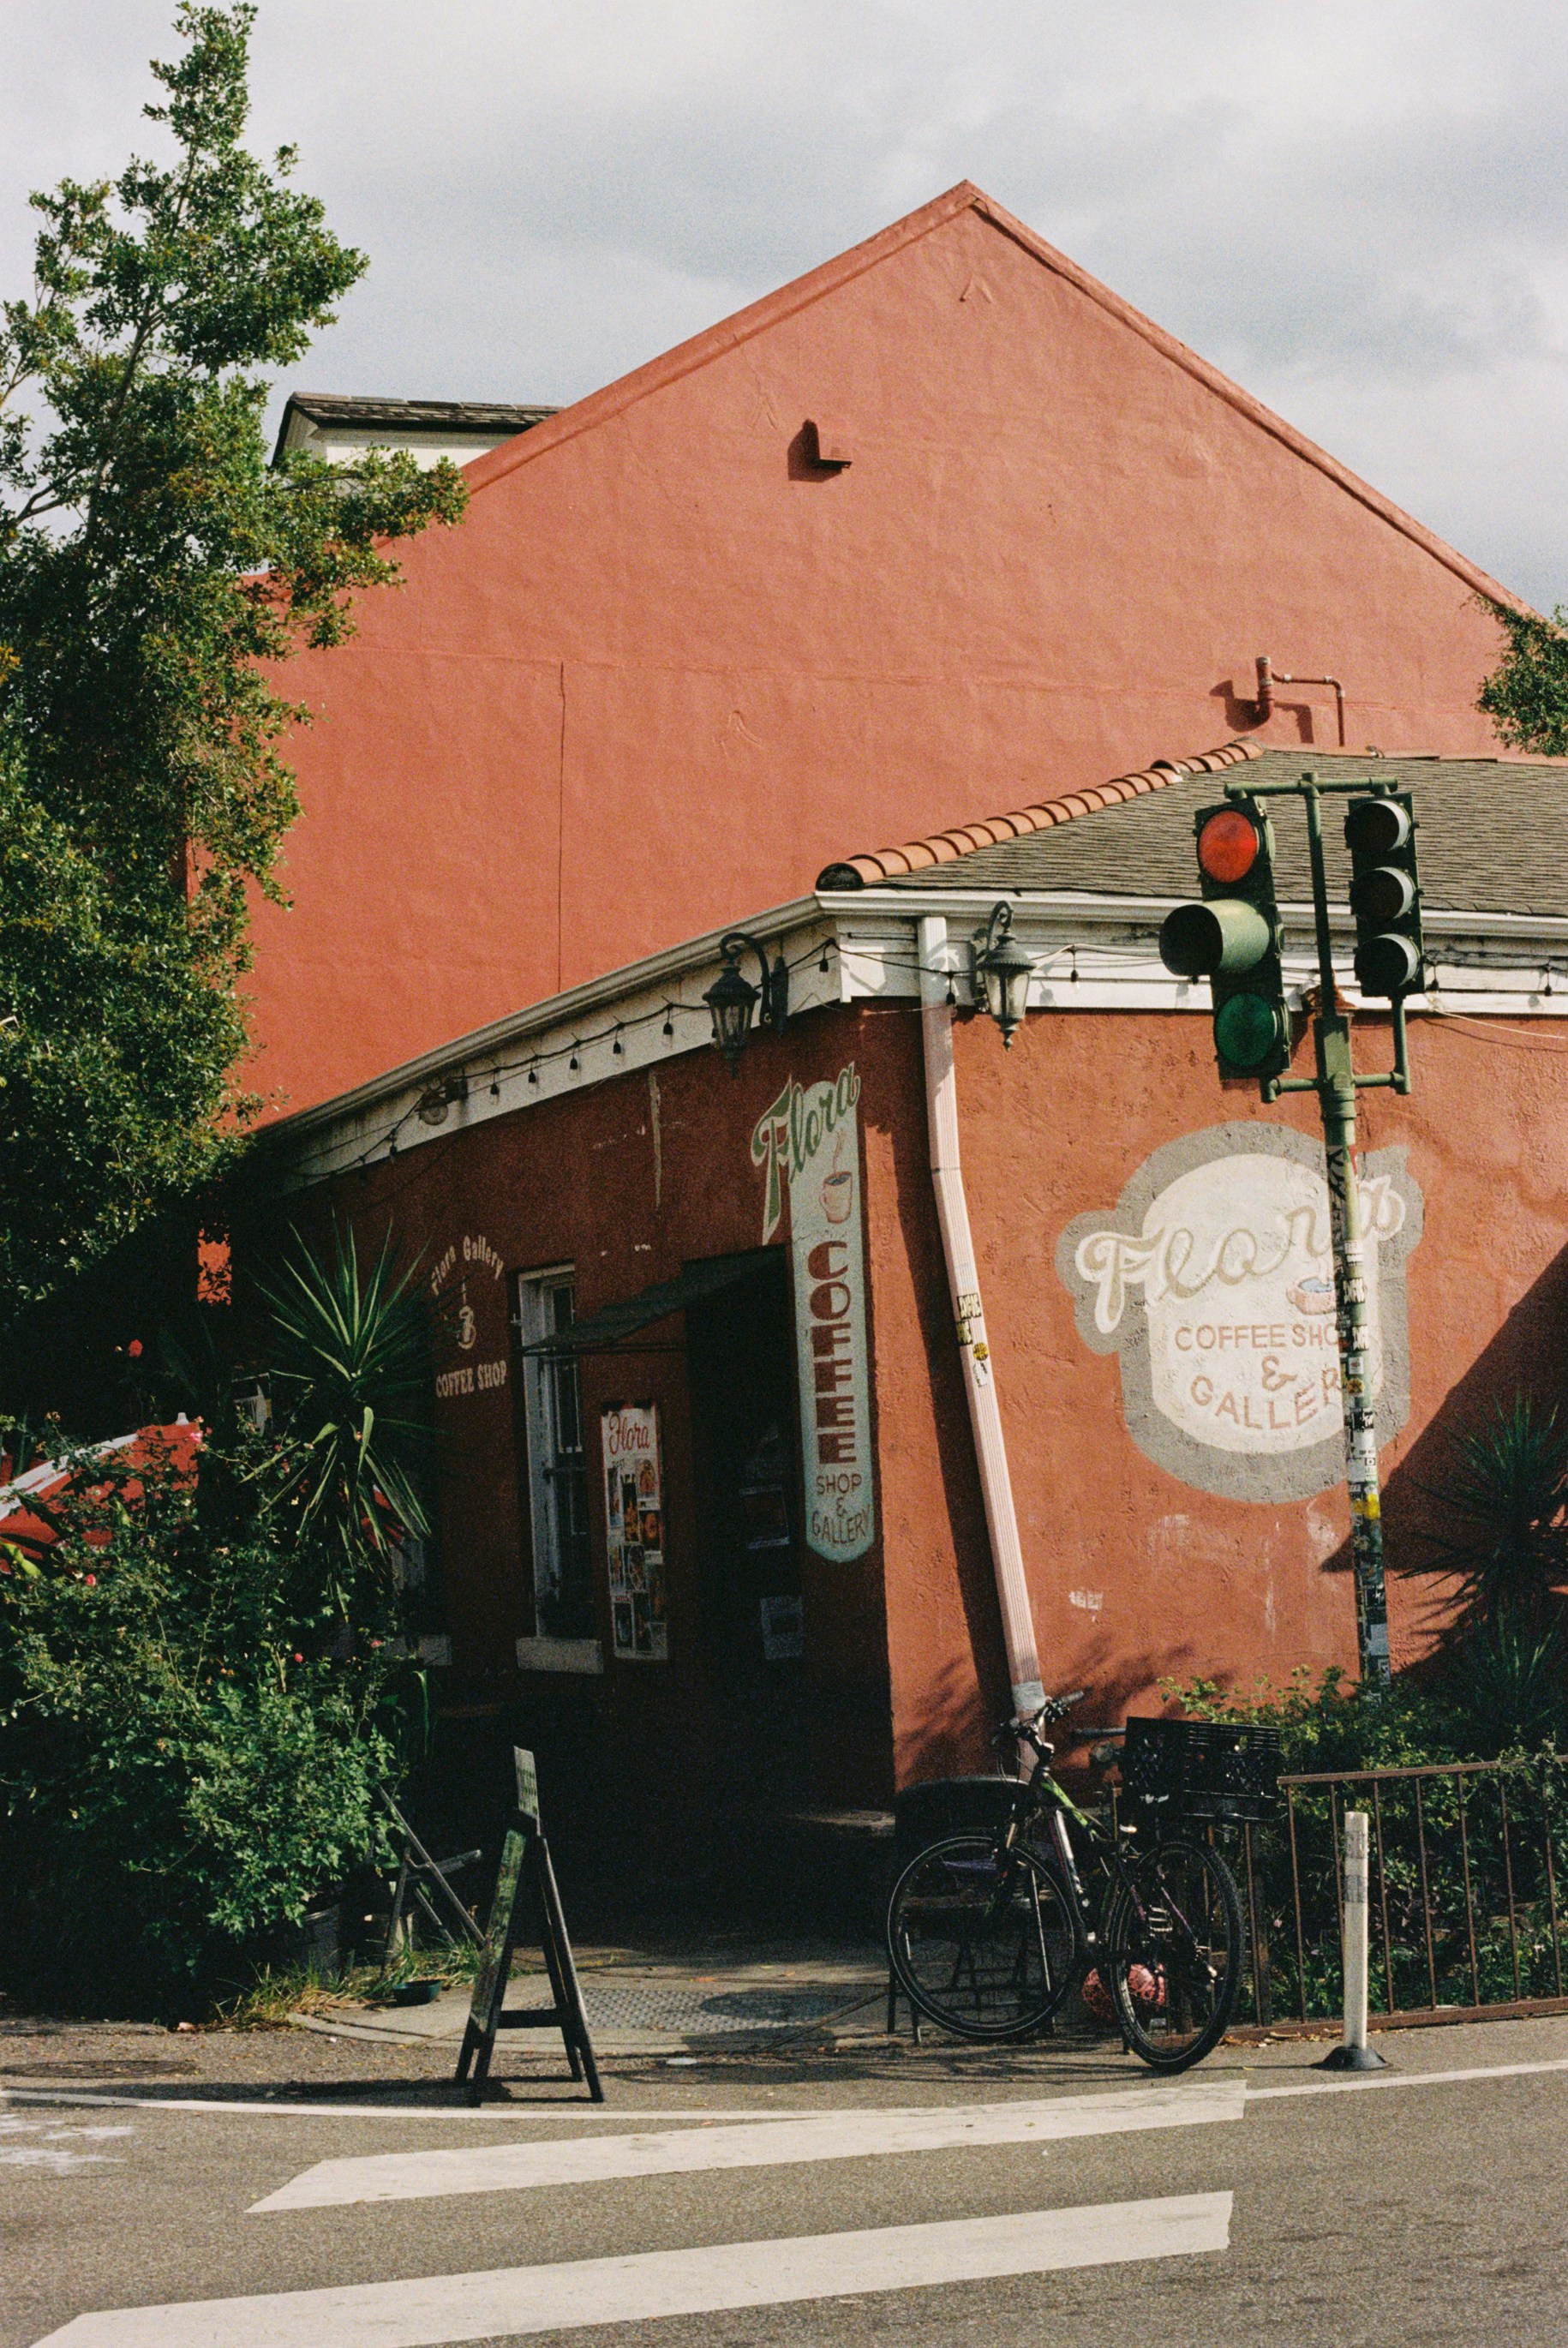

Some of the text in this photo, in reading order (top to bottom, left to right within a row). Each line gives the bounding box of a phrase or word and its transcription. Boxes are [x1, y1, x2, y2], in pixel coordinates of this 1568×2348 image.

[751, 1061, 861, 1246] Flora
[463, 1234, 504, 1280] Gallery
[808, 1240, 857, 1465] COFFEE
[1175, 1325, 1284, 1351] COFFEE
[1291, 1324, 1339, 1351] SHO
[436, 1360, 507, 1399] COFFEE SHOP
[1261, 1355, 1297, 1392] &
[1190, 1368, 1344, 1430] GALLER
[608, 1412, 650, 1455] Flora
[816, 1473, 862, 1496] SHOP
[811, 1504, 871, 1544] GALLERY
[835, 1496, 847, 1518] &
